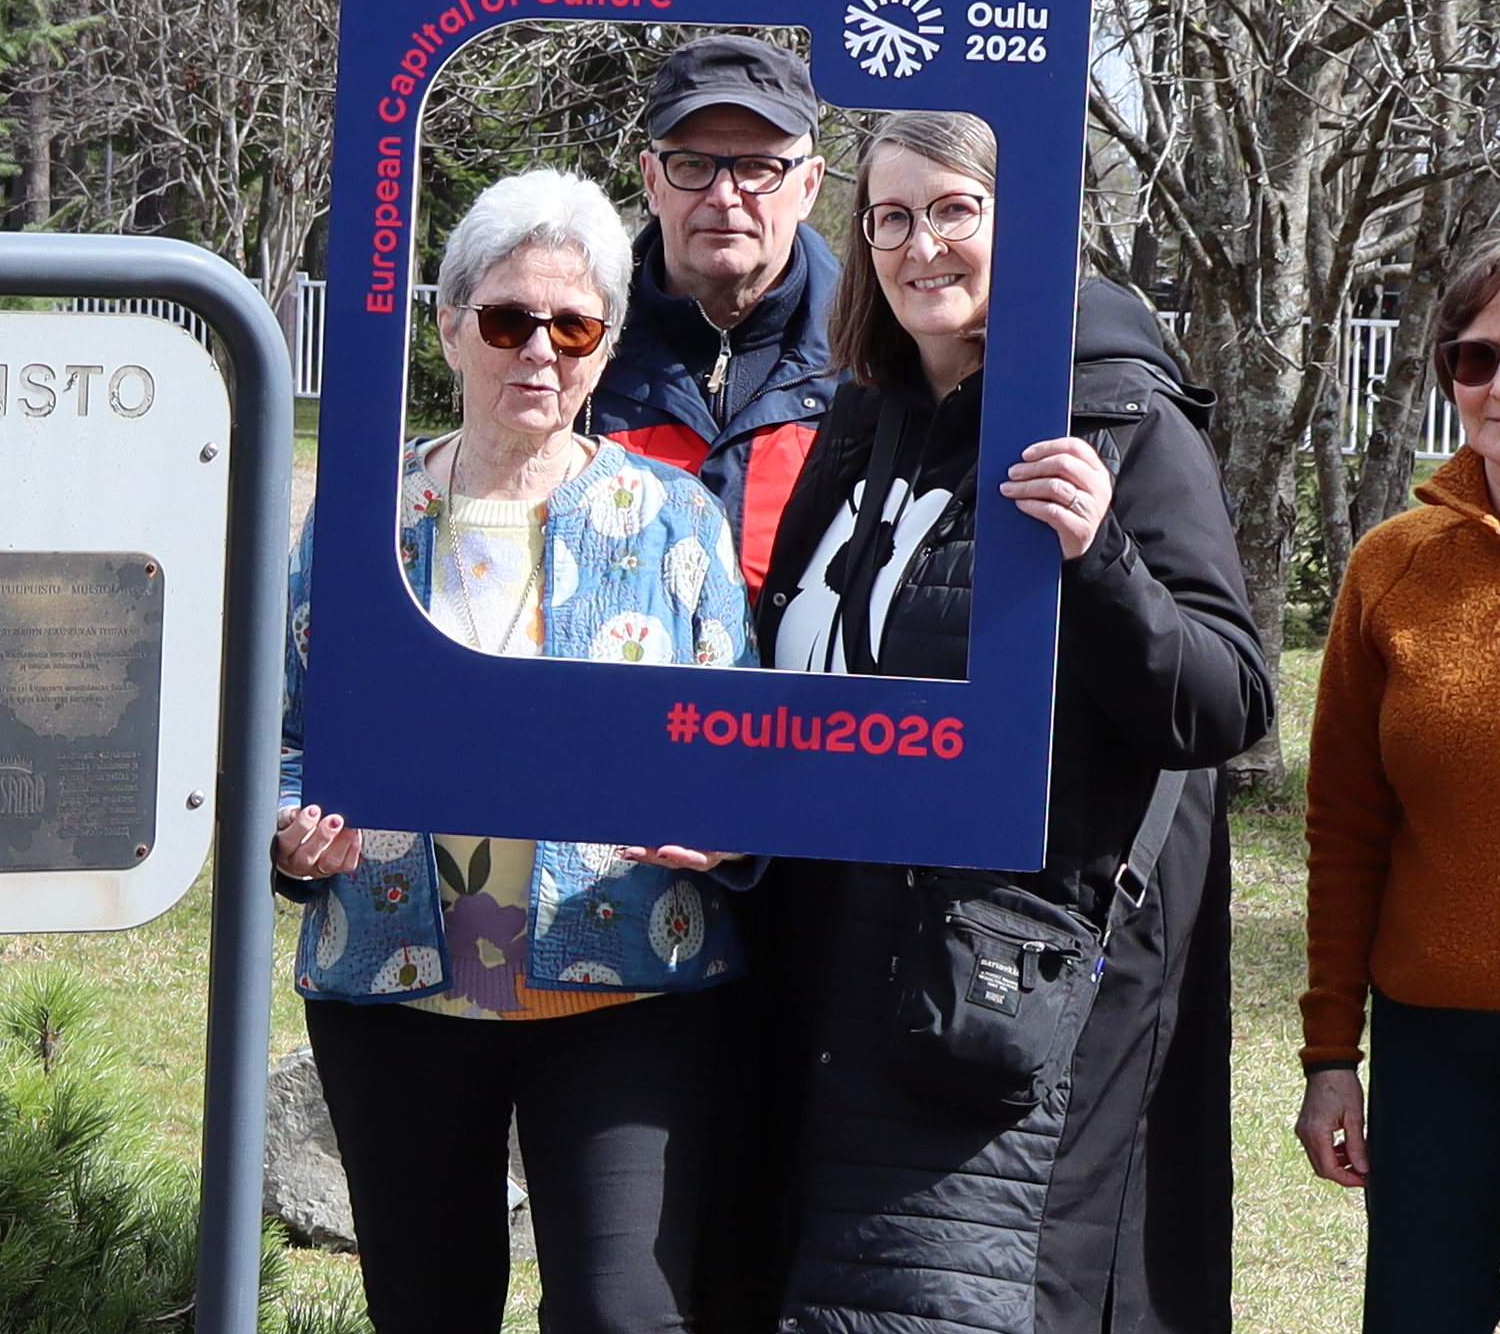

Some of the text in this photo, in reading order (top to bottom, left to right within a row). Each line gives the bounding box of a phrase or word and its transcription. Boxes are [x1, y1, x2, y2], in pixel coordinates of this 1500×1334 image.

[967, 1, 1048, 30] Oulu
[965, 34, 1047, 63] 2026
[366, 136, 402, 313] European
[666, 702, 964, 760] #oulu2026
